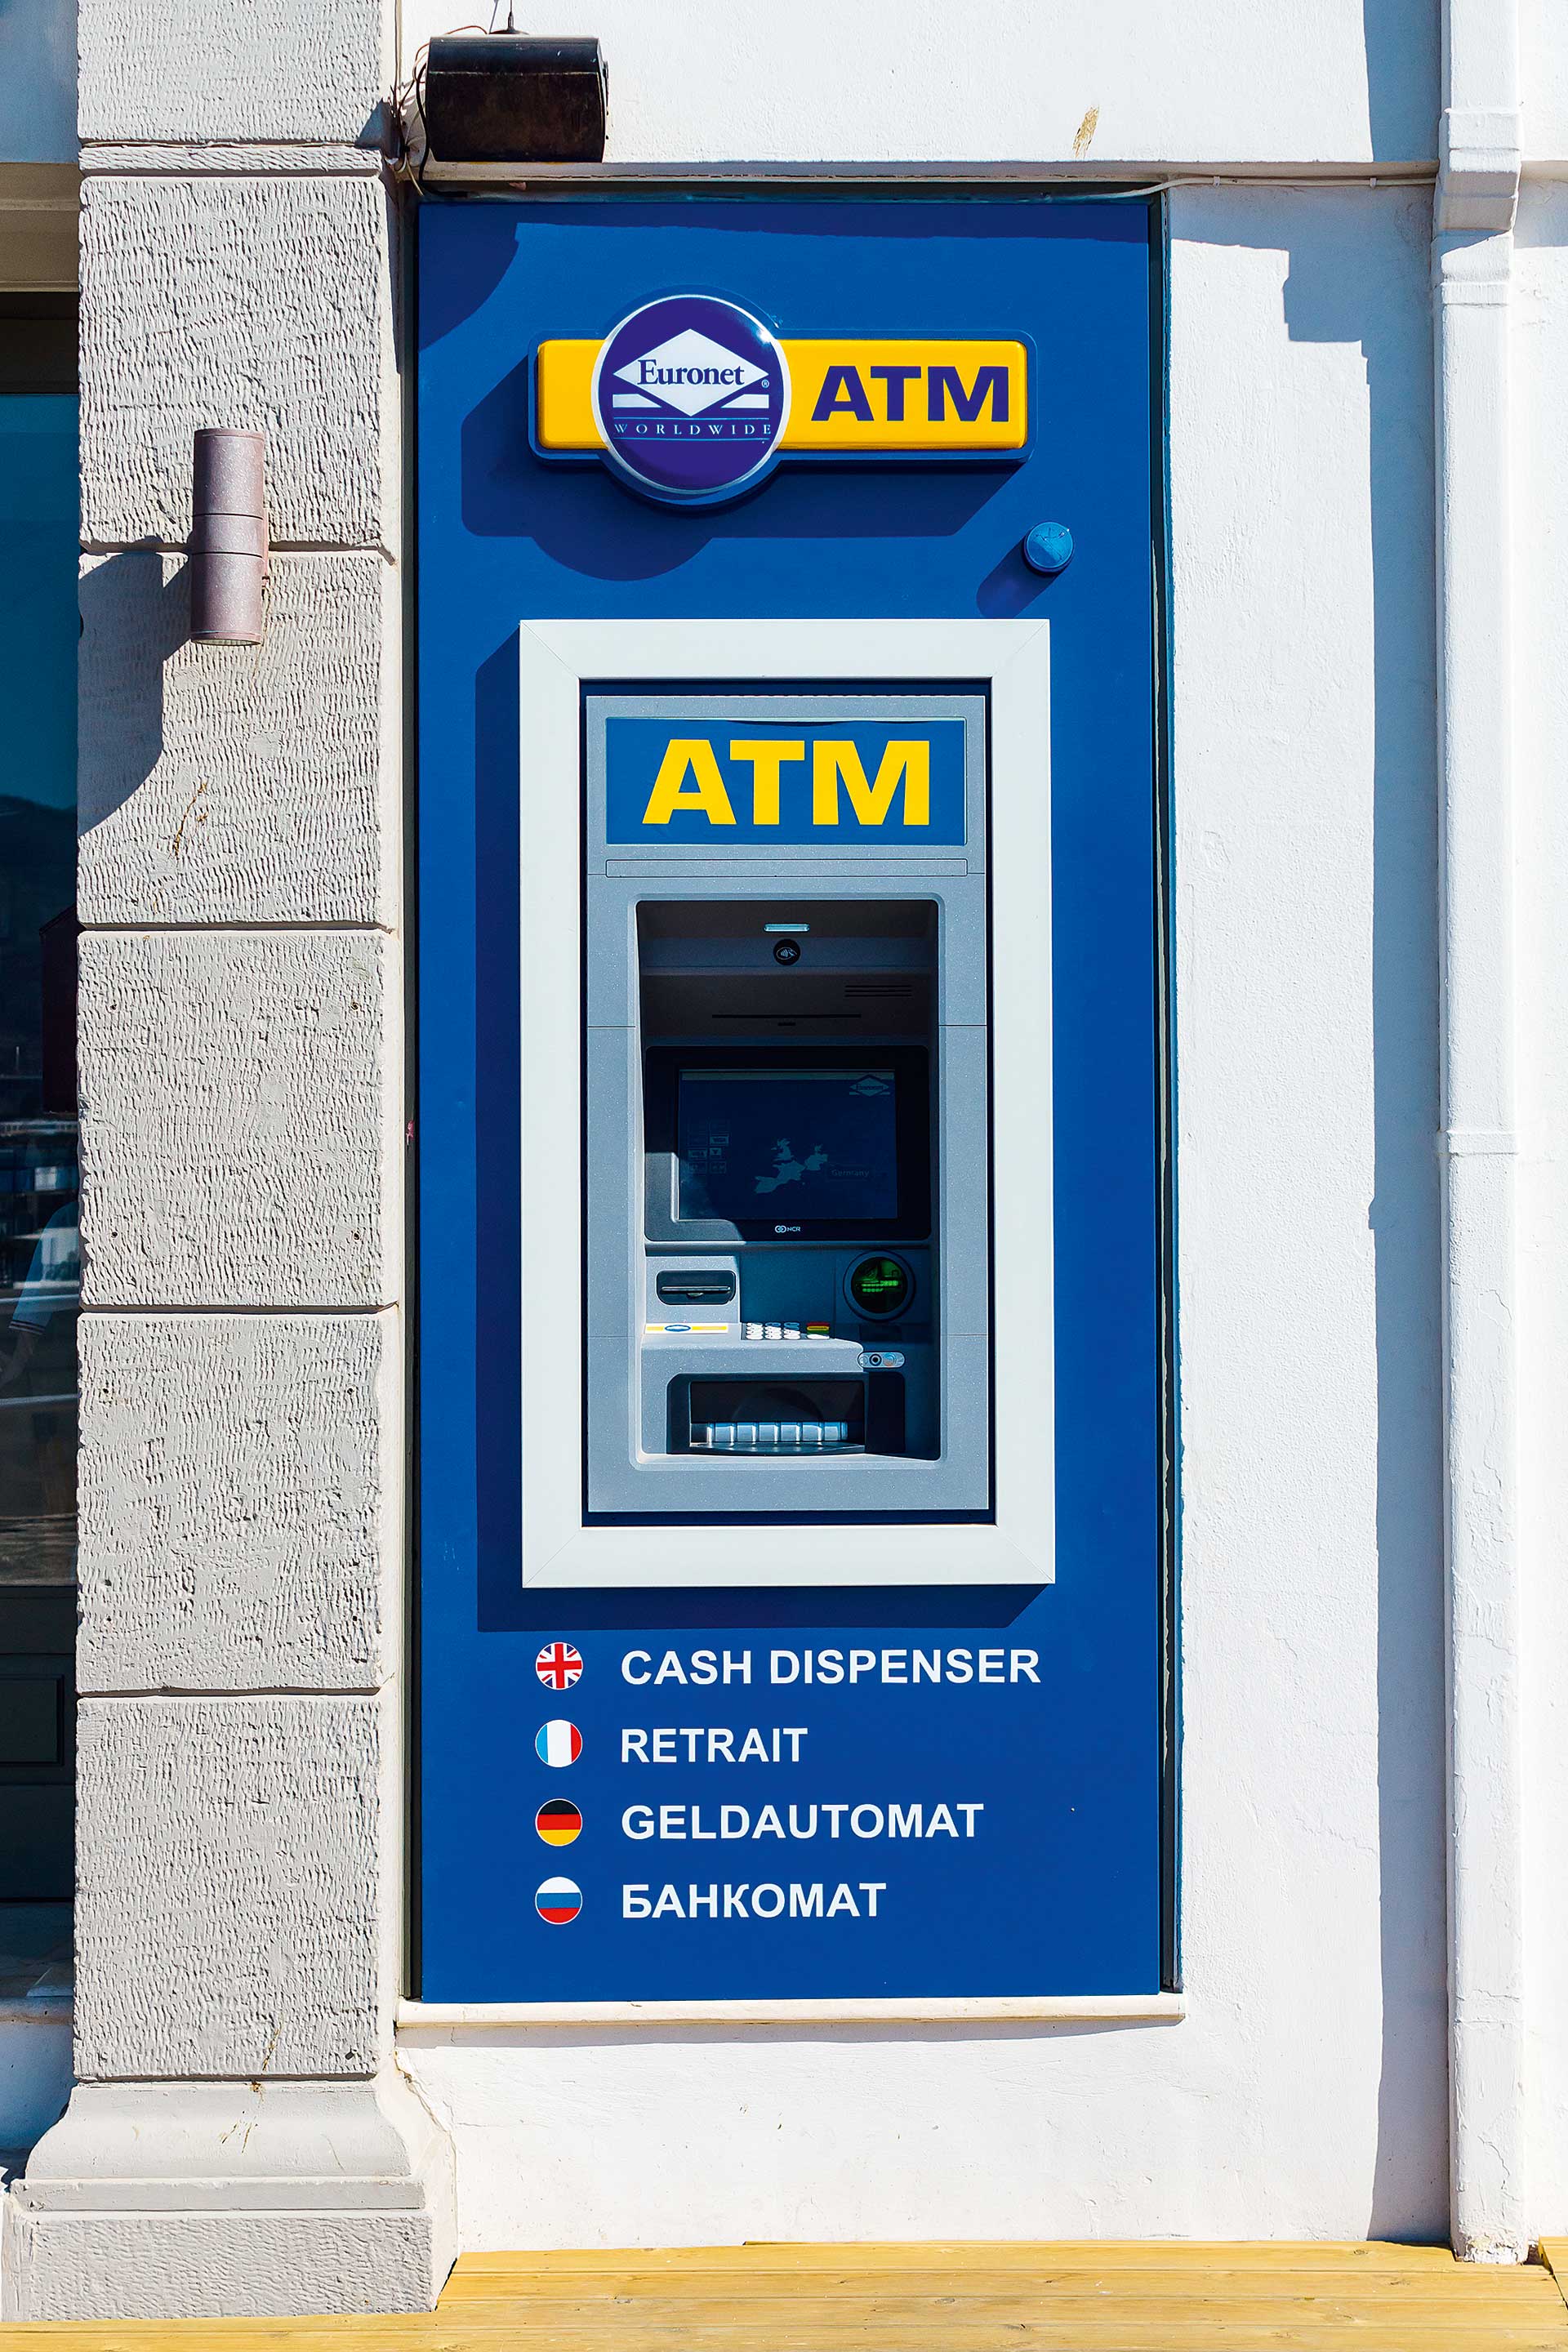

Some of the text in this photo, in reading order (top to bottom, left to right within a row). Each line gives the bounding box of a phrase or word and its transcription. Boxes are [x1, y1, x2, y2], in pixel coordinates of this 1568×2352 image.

[637, 358, 745, 386] Euronet
[810, 364, 1009, 422] ATM
[613, 423, 773, 436] WORLDWIDE
[642, 739, 930, 826] ATM
[621, 1648, 1041, 1686] CASH DISPENSER
[621, 1727, 808, 1763] RETRAIT
[621, 1802, 985, 1840] GELDAUTOMAT
[621, 1882, 887, 1919] БАНКОМАТ
